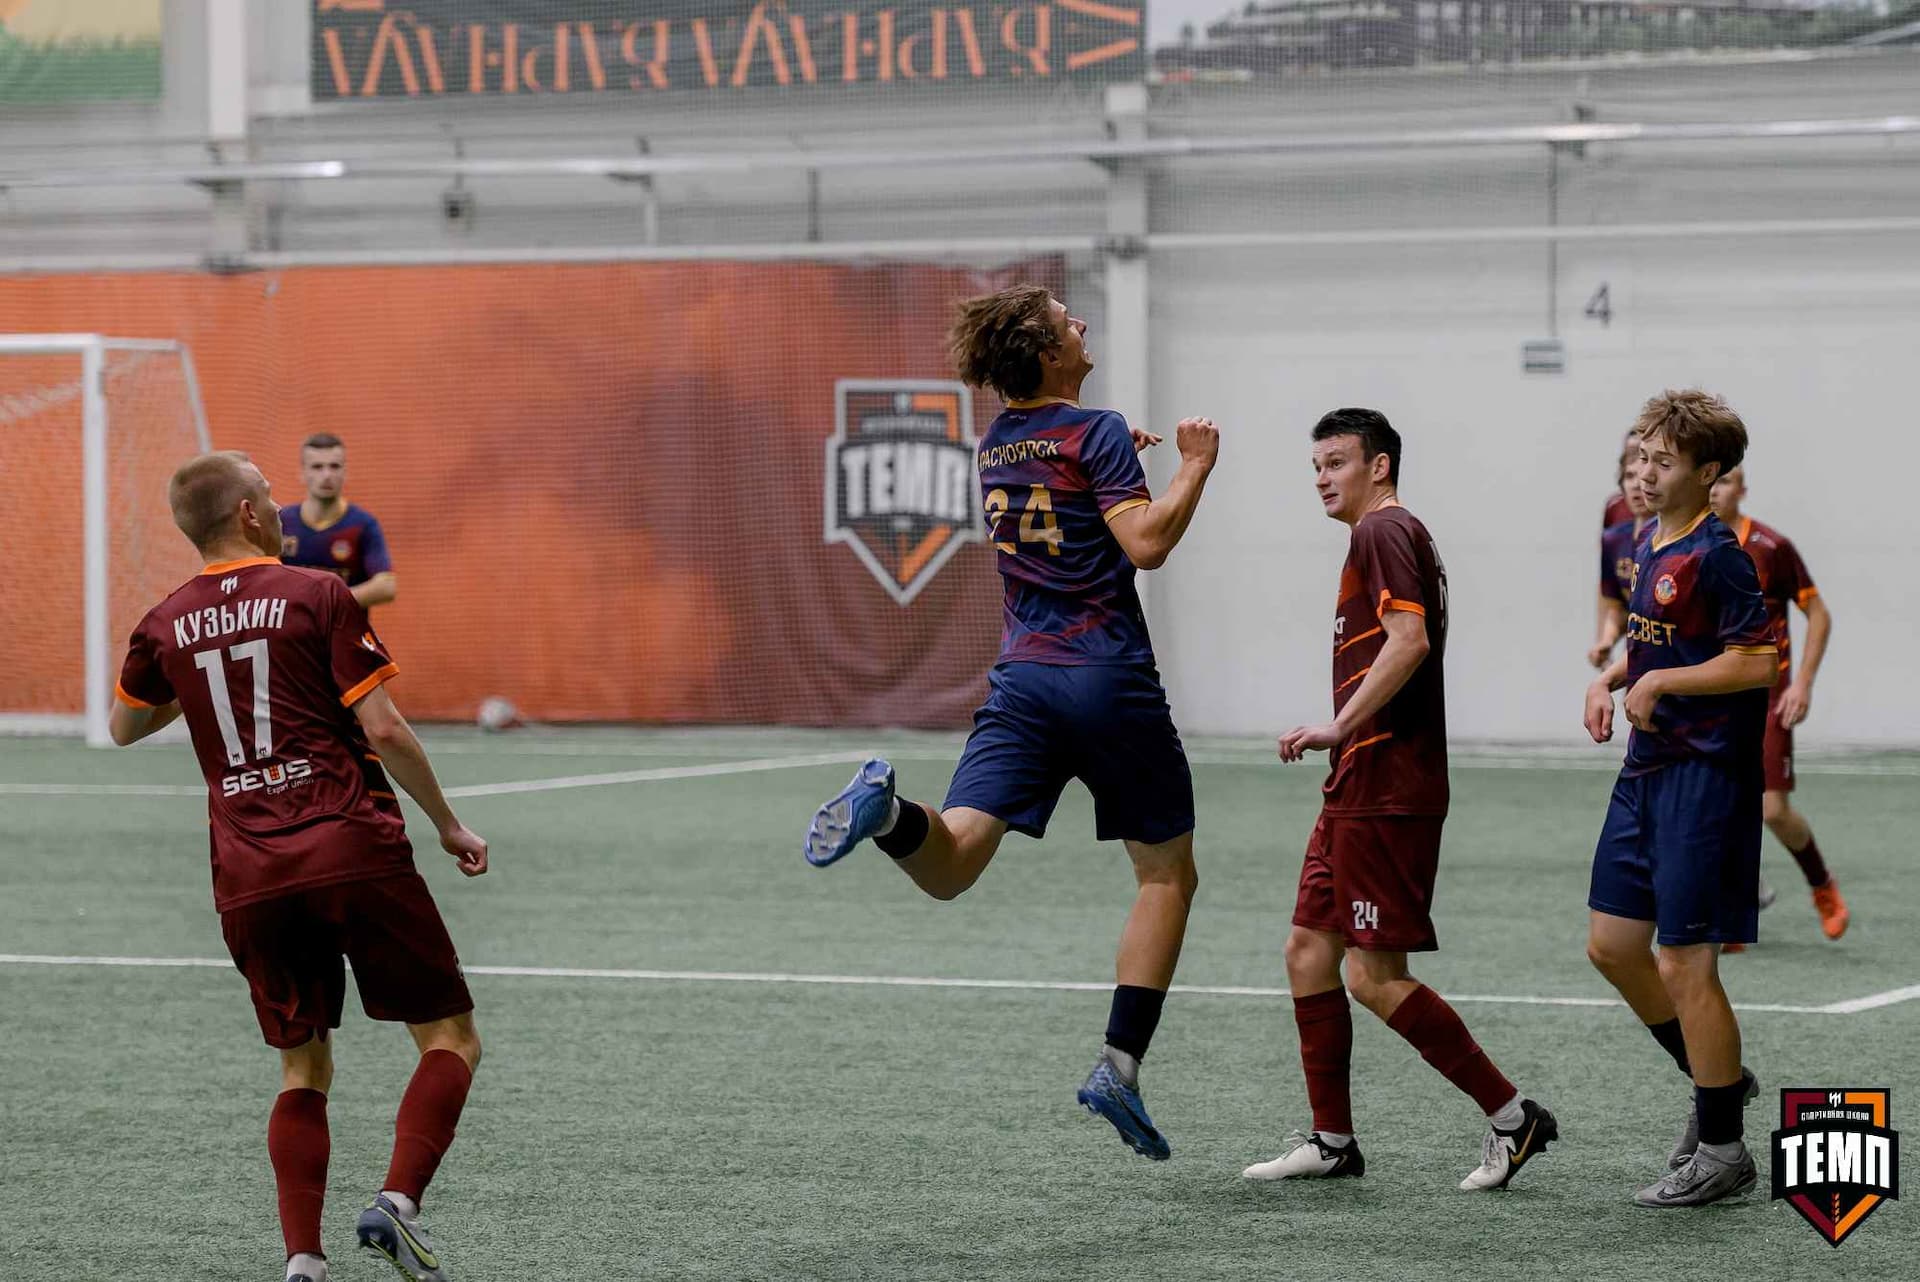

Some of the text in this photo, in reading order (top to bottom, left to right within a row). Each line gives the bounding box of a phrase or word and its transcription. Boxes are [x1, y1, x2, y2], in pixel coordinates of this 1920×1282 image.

[1586, 281, 1612, 328] 4
[979, 440, 1062, 471] РАСНОЯРСК
[840, 442, 968, 521] ТЕМП
[985, 483, 1064, 556] 24
[173, 598, 287, 650] КУЗЬКИН
[194, 638, 273, 768] 17
[222, 759, 312, 797] SEUS
[1352, 900, 1379, 930] 24
